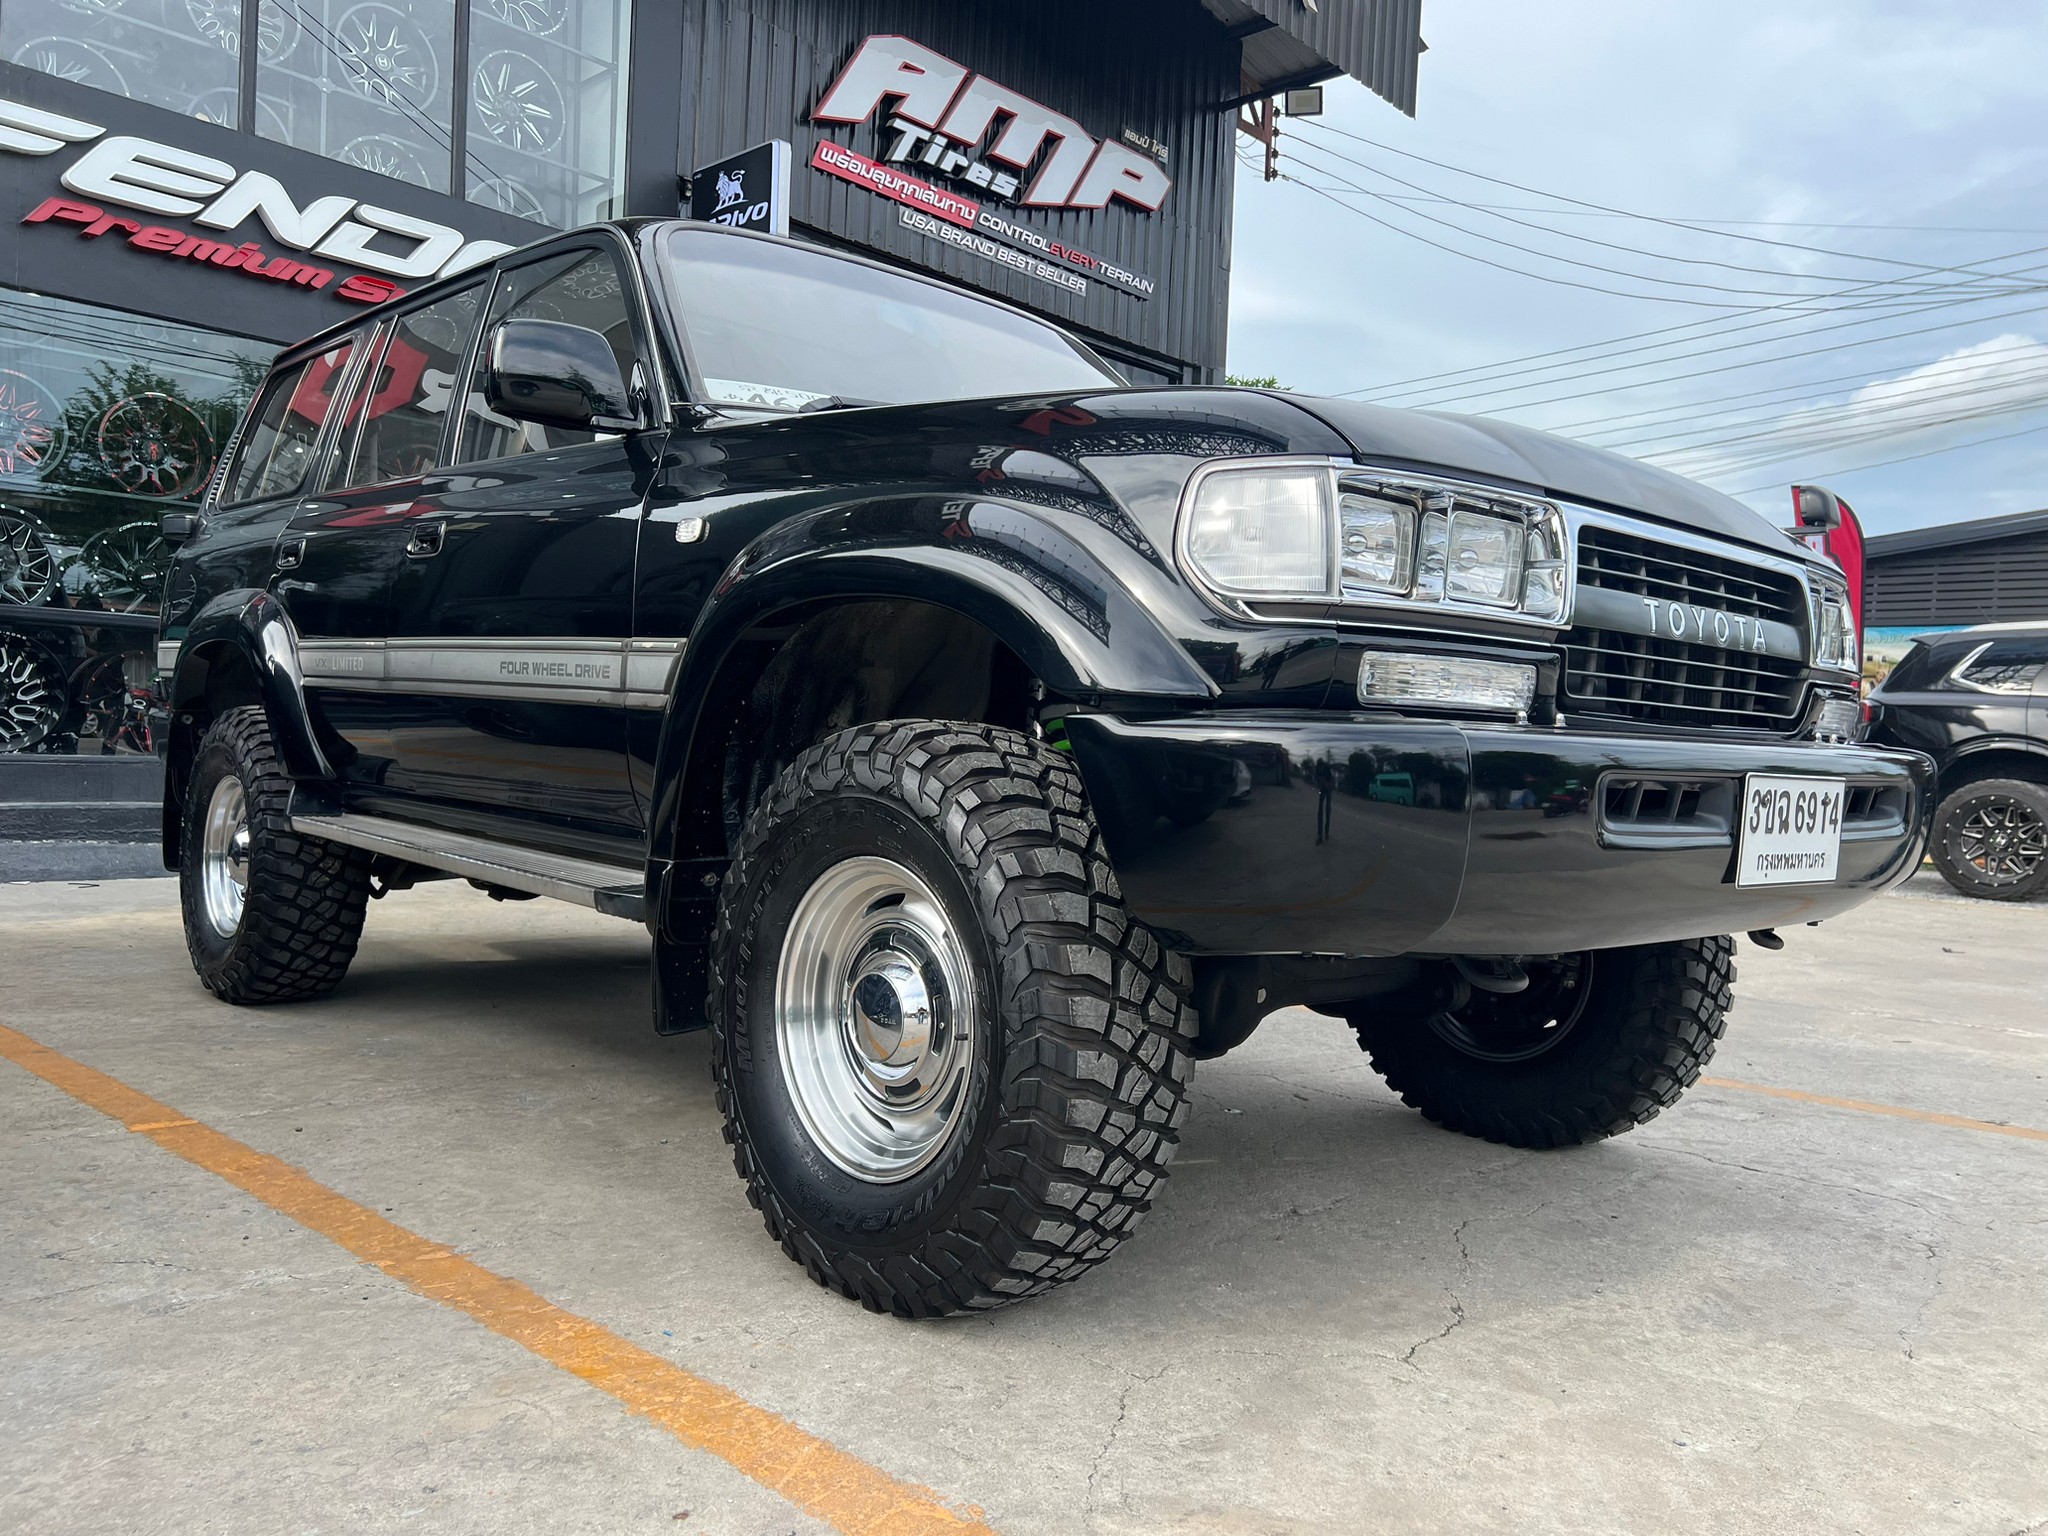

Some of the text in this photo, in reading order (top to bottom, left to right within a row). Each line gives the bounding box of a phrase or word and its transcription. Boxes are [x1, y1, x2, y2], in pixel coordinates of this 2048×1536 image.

[812, 34, 1172, 211] AMP
[820, 146, 976, 221] พร้อมลุยทุกเส้นทาง
[889, 117, 1020, 200] Tires
[22, 197, 335, 290] Premium
[902, 210, 1087, 293] USA BRAND BEST SELLER
[1643, 598, 1767, 653] TOYOTA
[331, 656, 364, 672] LIMITED
[500, 660, 611, 680] FOUR WHEEL DRIVE
[1794, 790, 1840, 835] 6914
[1756, 852, 1826, 879] กรุงเทพมหานคร
